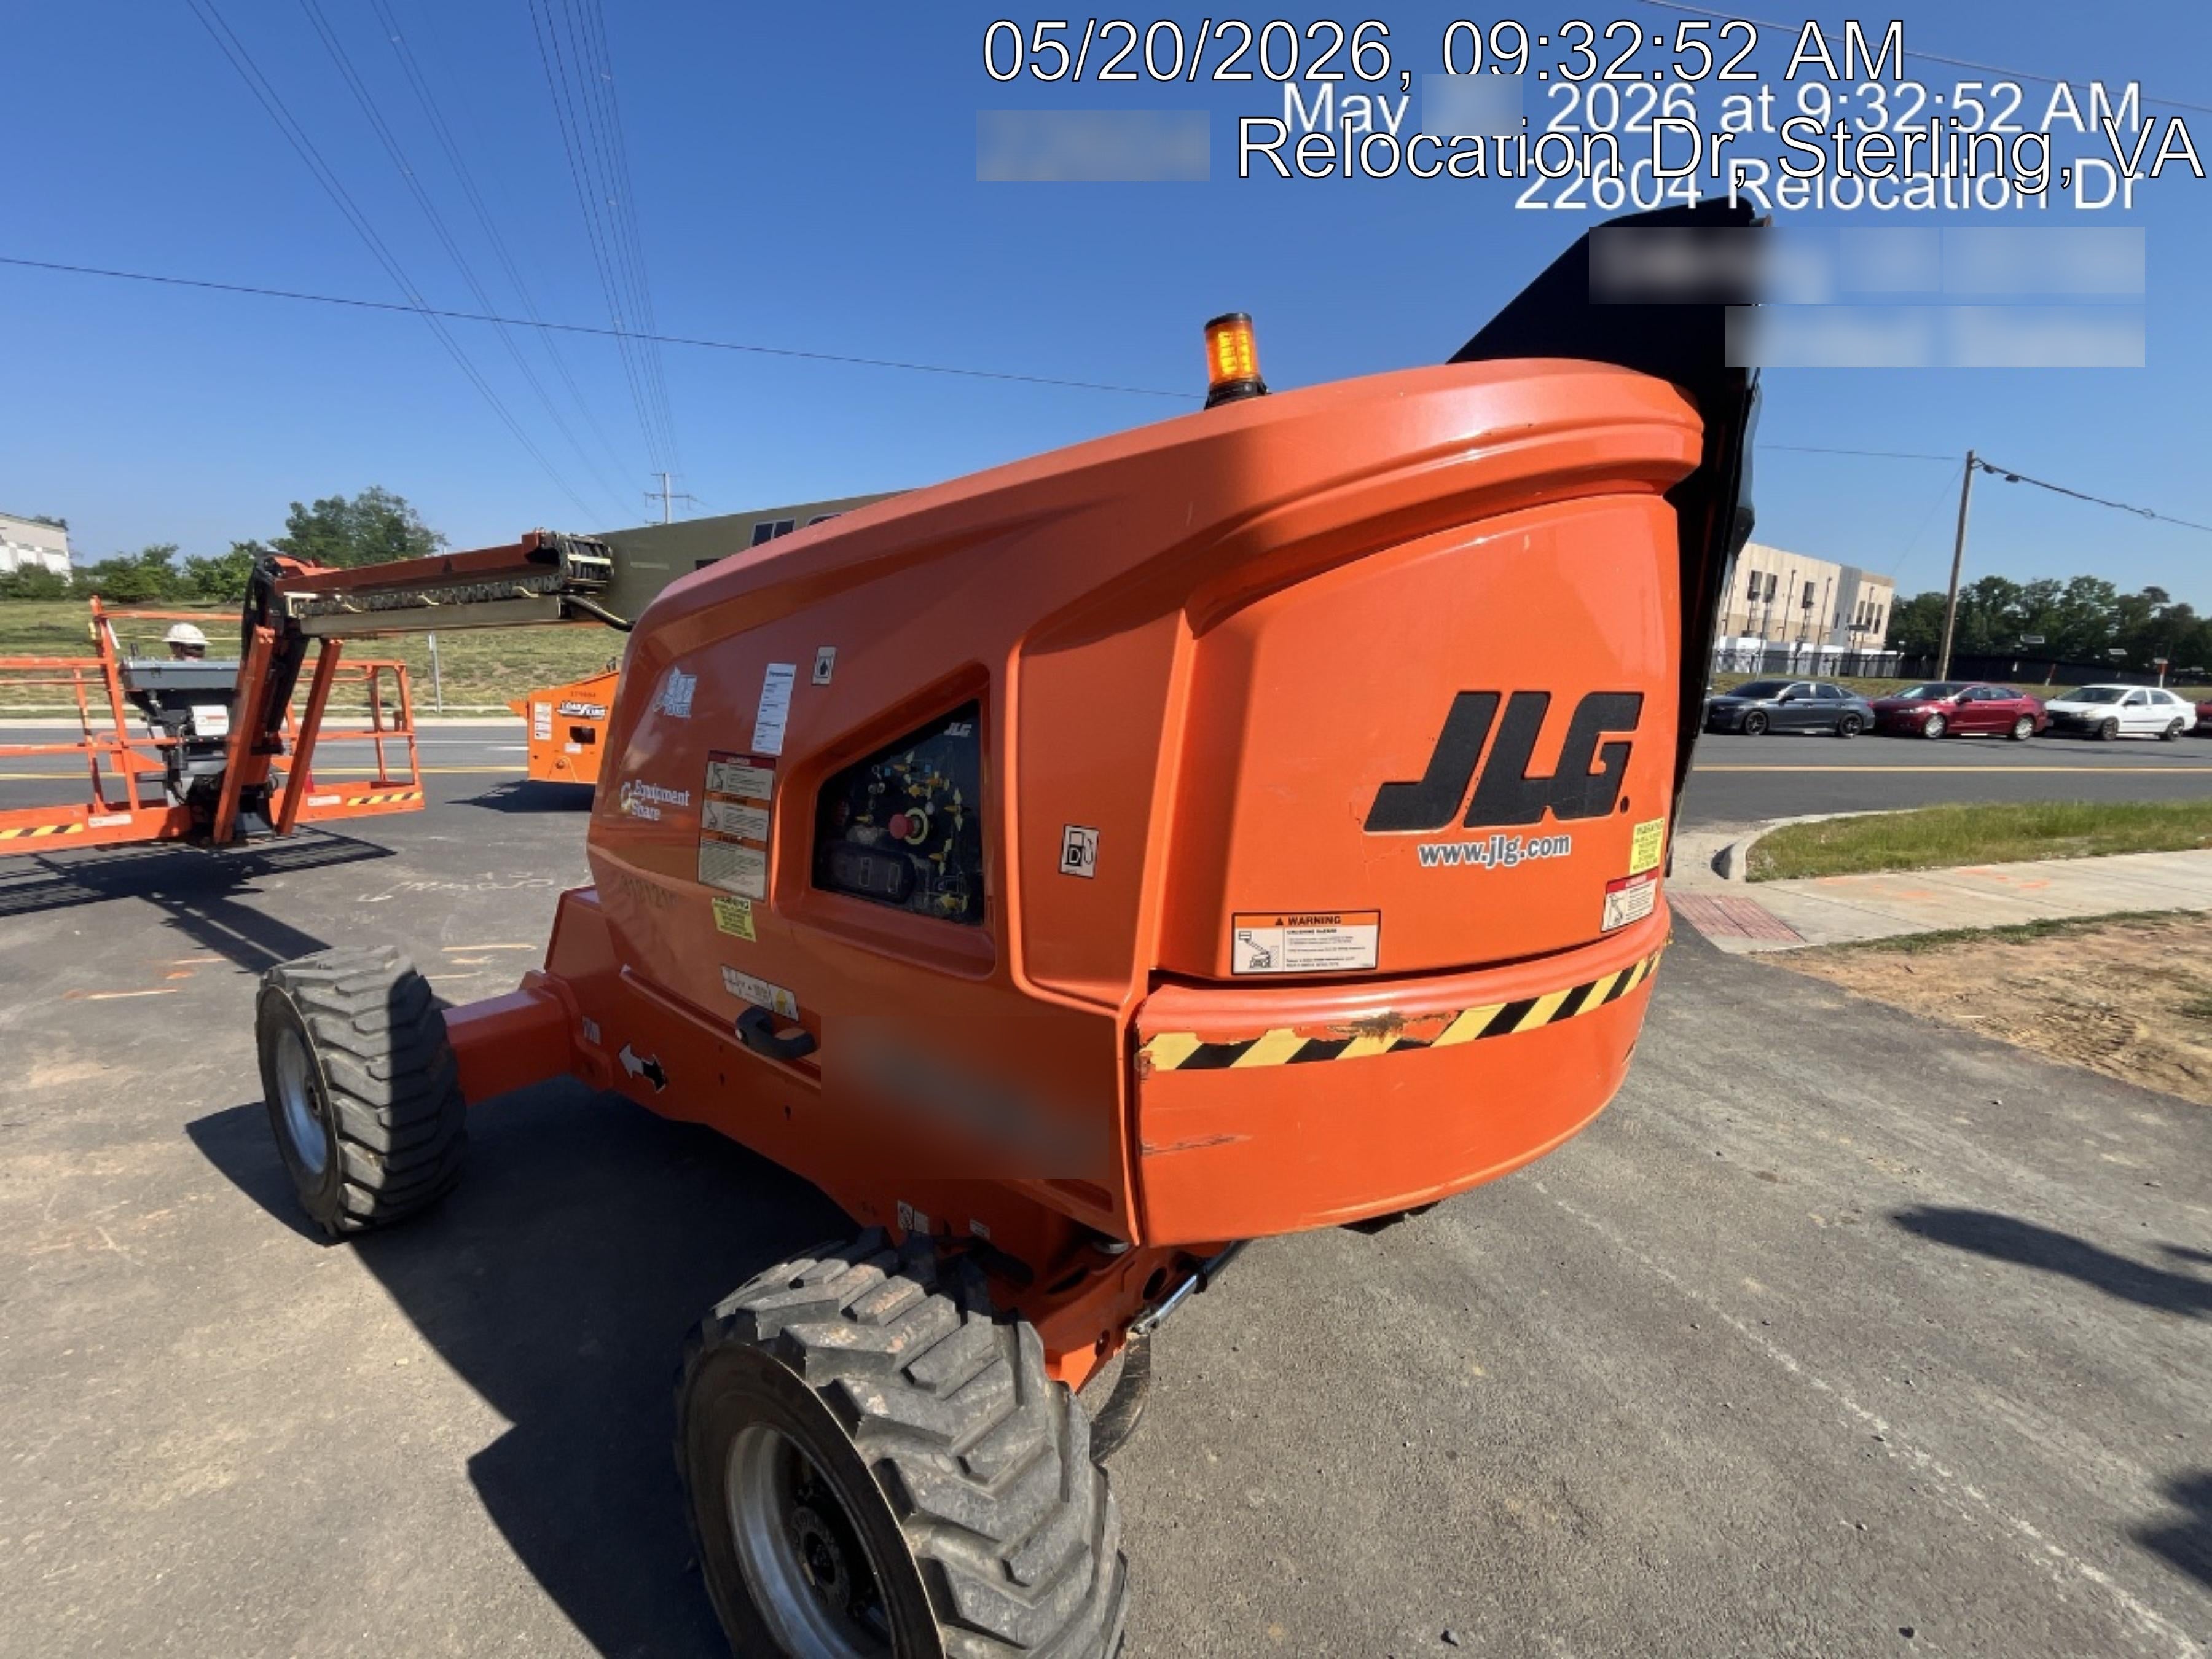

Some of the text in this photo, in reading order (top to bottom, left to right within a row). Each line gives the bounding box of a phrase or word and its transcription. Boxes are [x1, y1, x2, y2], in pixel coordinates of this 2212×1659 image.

[943, 722, 972, 737] JLG
[1363, 691, 1644, 832] JLG
[1069, 847, 1081, 864] D
[1418, 834, 1572, 869] www.jlg.com
[1287, 915, 1341, 927] WARNING
